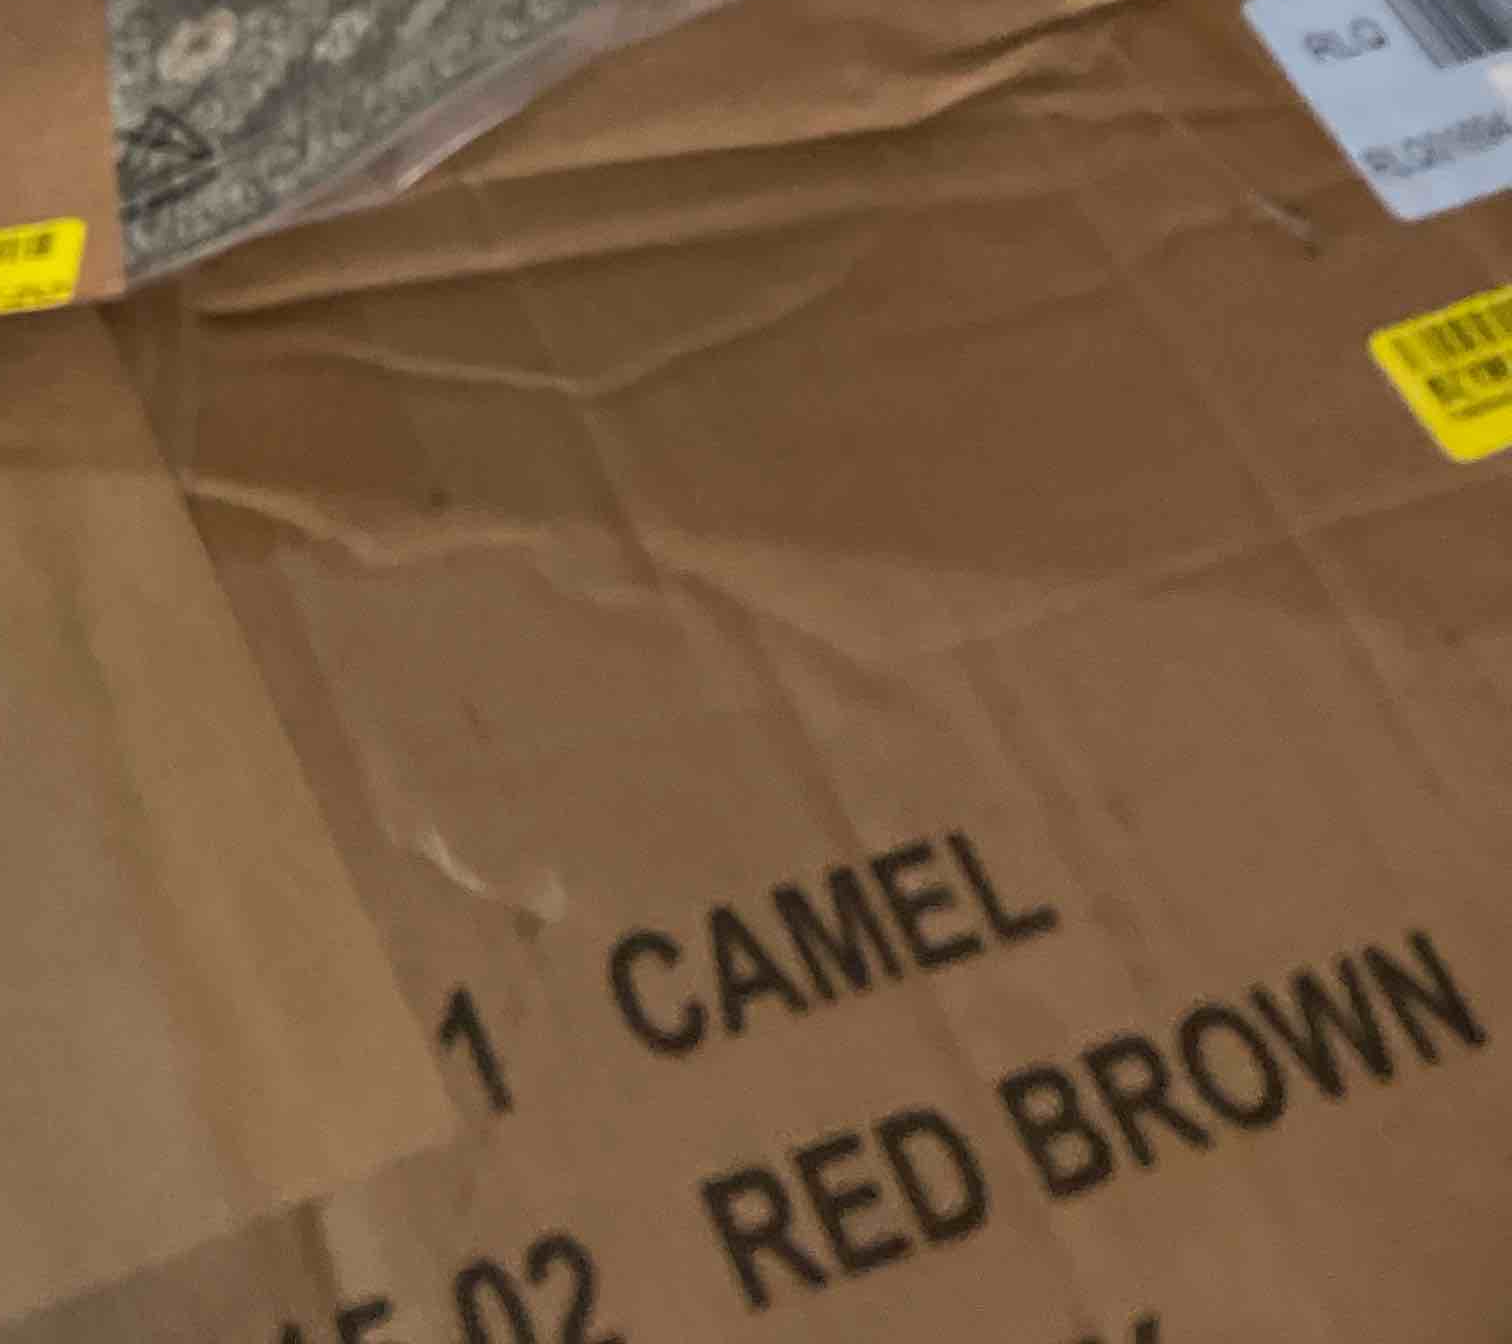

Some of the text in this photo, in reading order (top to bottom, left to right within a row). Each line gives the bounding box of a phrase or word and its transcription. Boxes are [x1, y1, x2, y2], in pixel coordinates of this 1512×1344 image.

[604, 829, 1060, 1060] CAMEL
[699, 1105, 990, 1315] RED
[996, 927, 1488, 1204] BROWN
